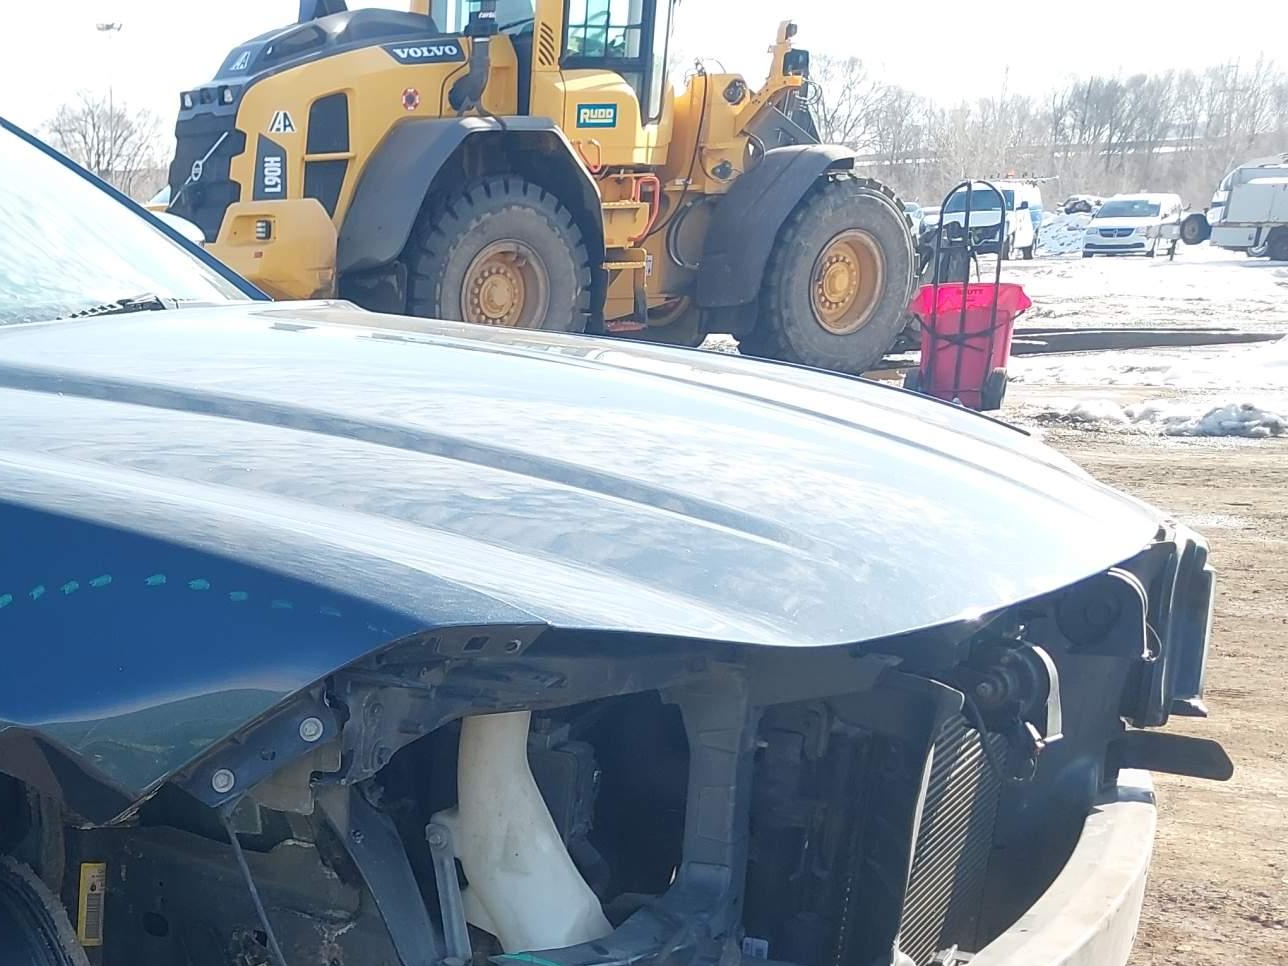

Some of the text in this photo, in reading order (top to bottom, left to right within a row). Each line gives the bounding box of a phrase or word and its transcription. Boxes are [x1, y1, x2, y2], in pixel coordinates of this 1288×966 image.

[392, 45, 458, 59] VOLVO
[579, 108, 614, 123] RUDD
[264, 156, 282, 193] L90H
